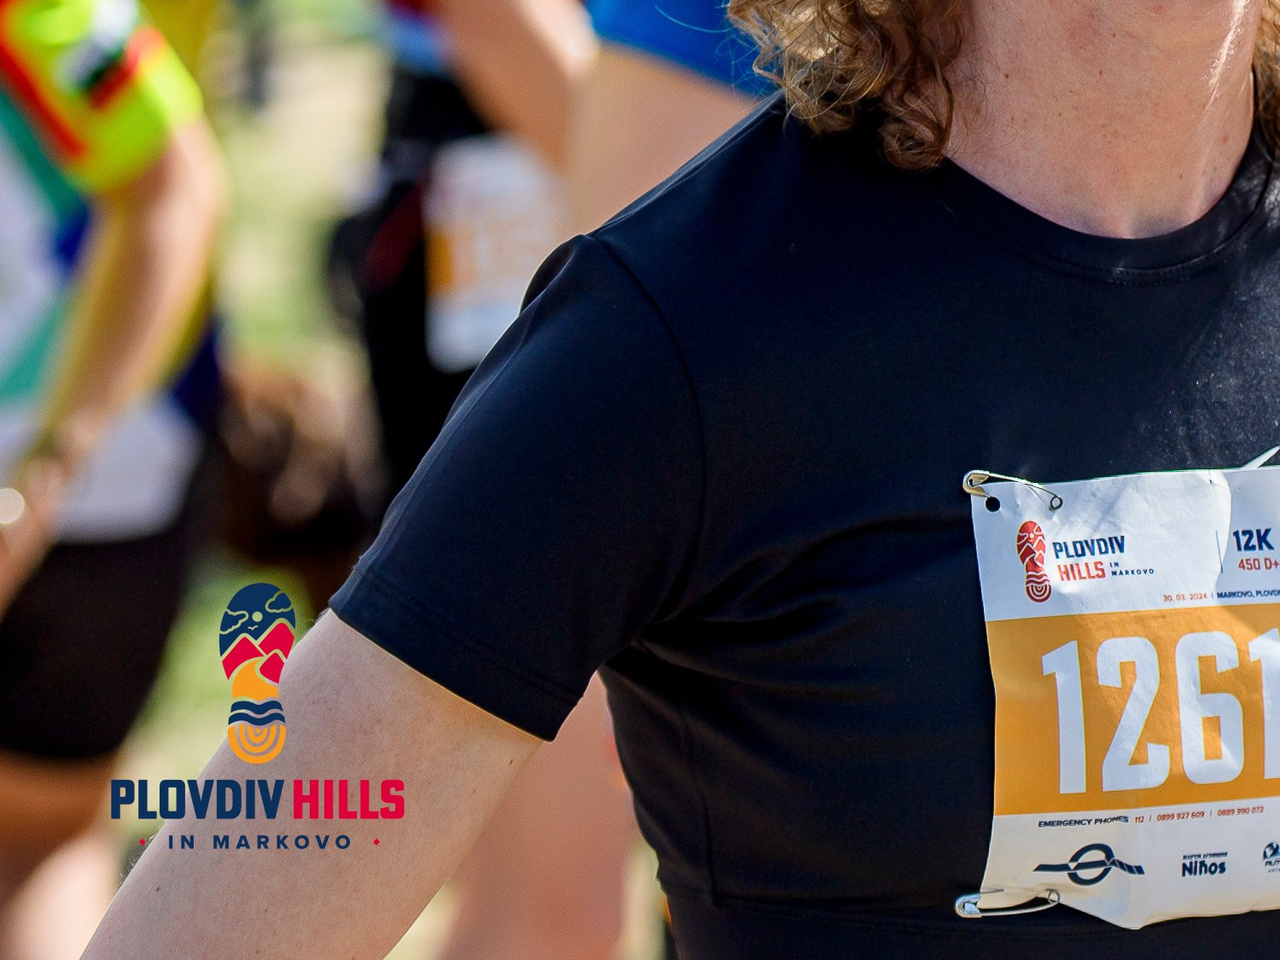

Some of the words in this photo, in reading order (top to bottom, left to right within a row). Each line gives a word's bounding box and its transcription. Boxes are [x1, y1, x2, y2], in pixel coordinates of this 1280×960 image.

[1052, 535, 1125, 559] PLOVDIV
[1232, 528, 1275, 552] 12K
[1057, 561, 1106, 581] HILLS
[1238, 558, 1261, 571] 450
[1264, 557, 1279, 570] D+
[1111, 568, 1155, 576] MARKOVO
[1189, 592, 1207, 600] 2024
[1038, 818, 1093, 828] EMERGENCY
[1094, 815, 1129, 825] PHONES
